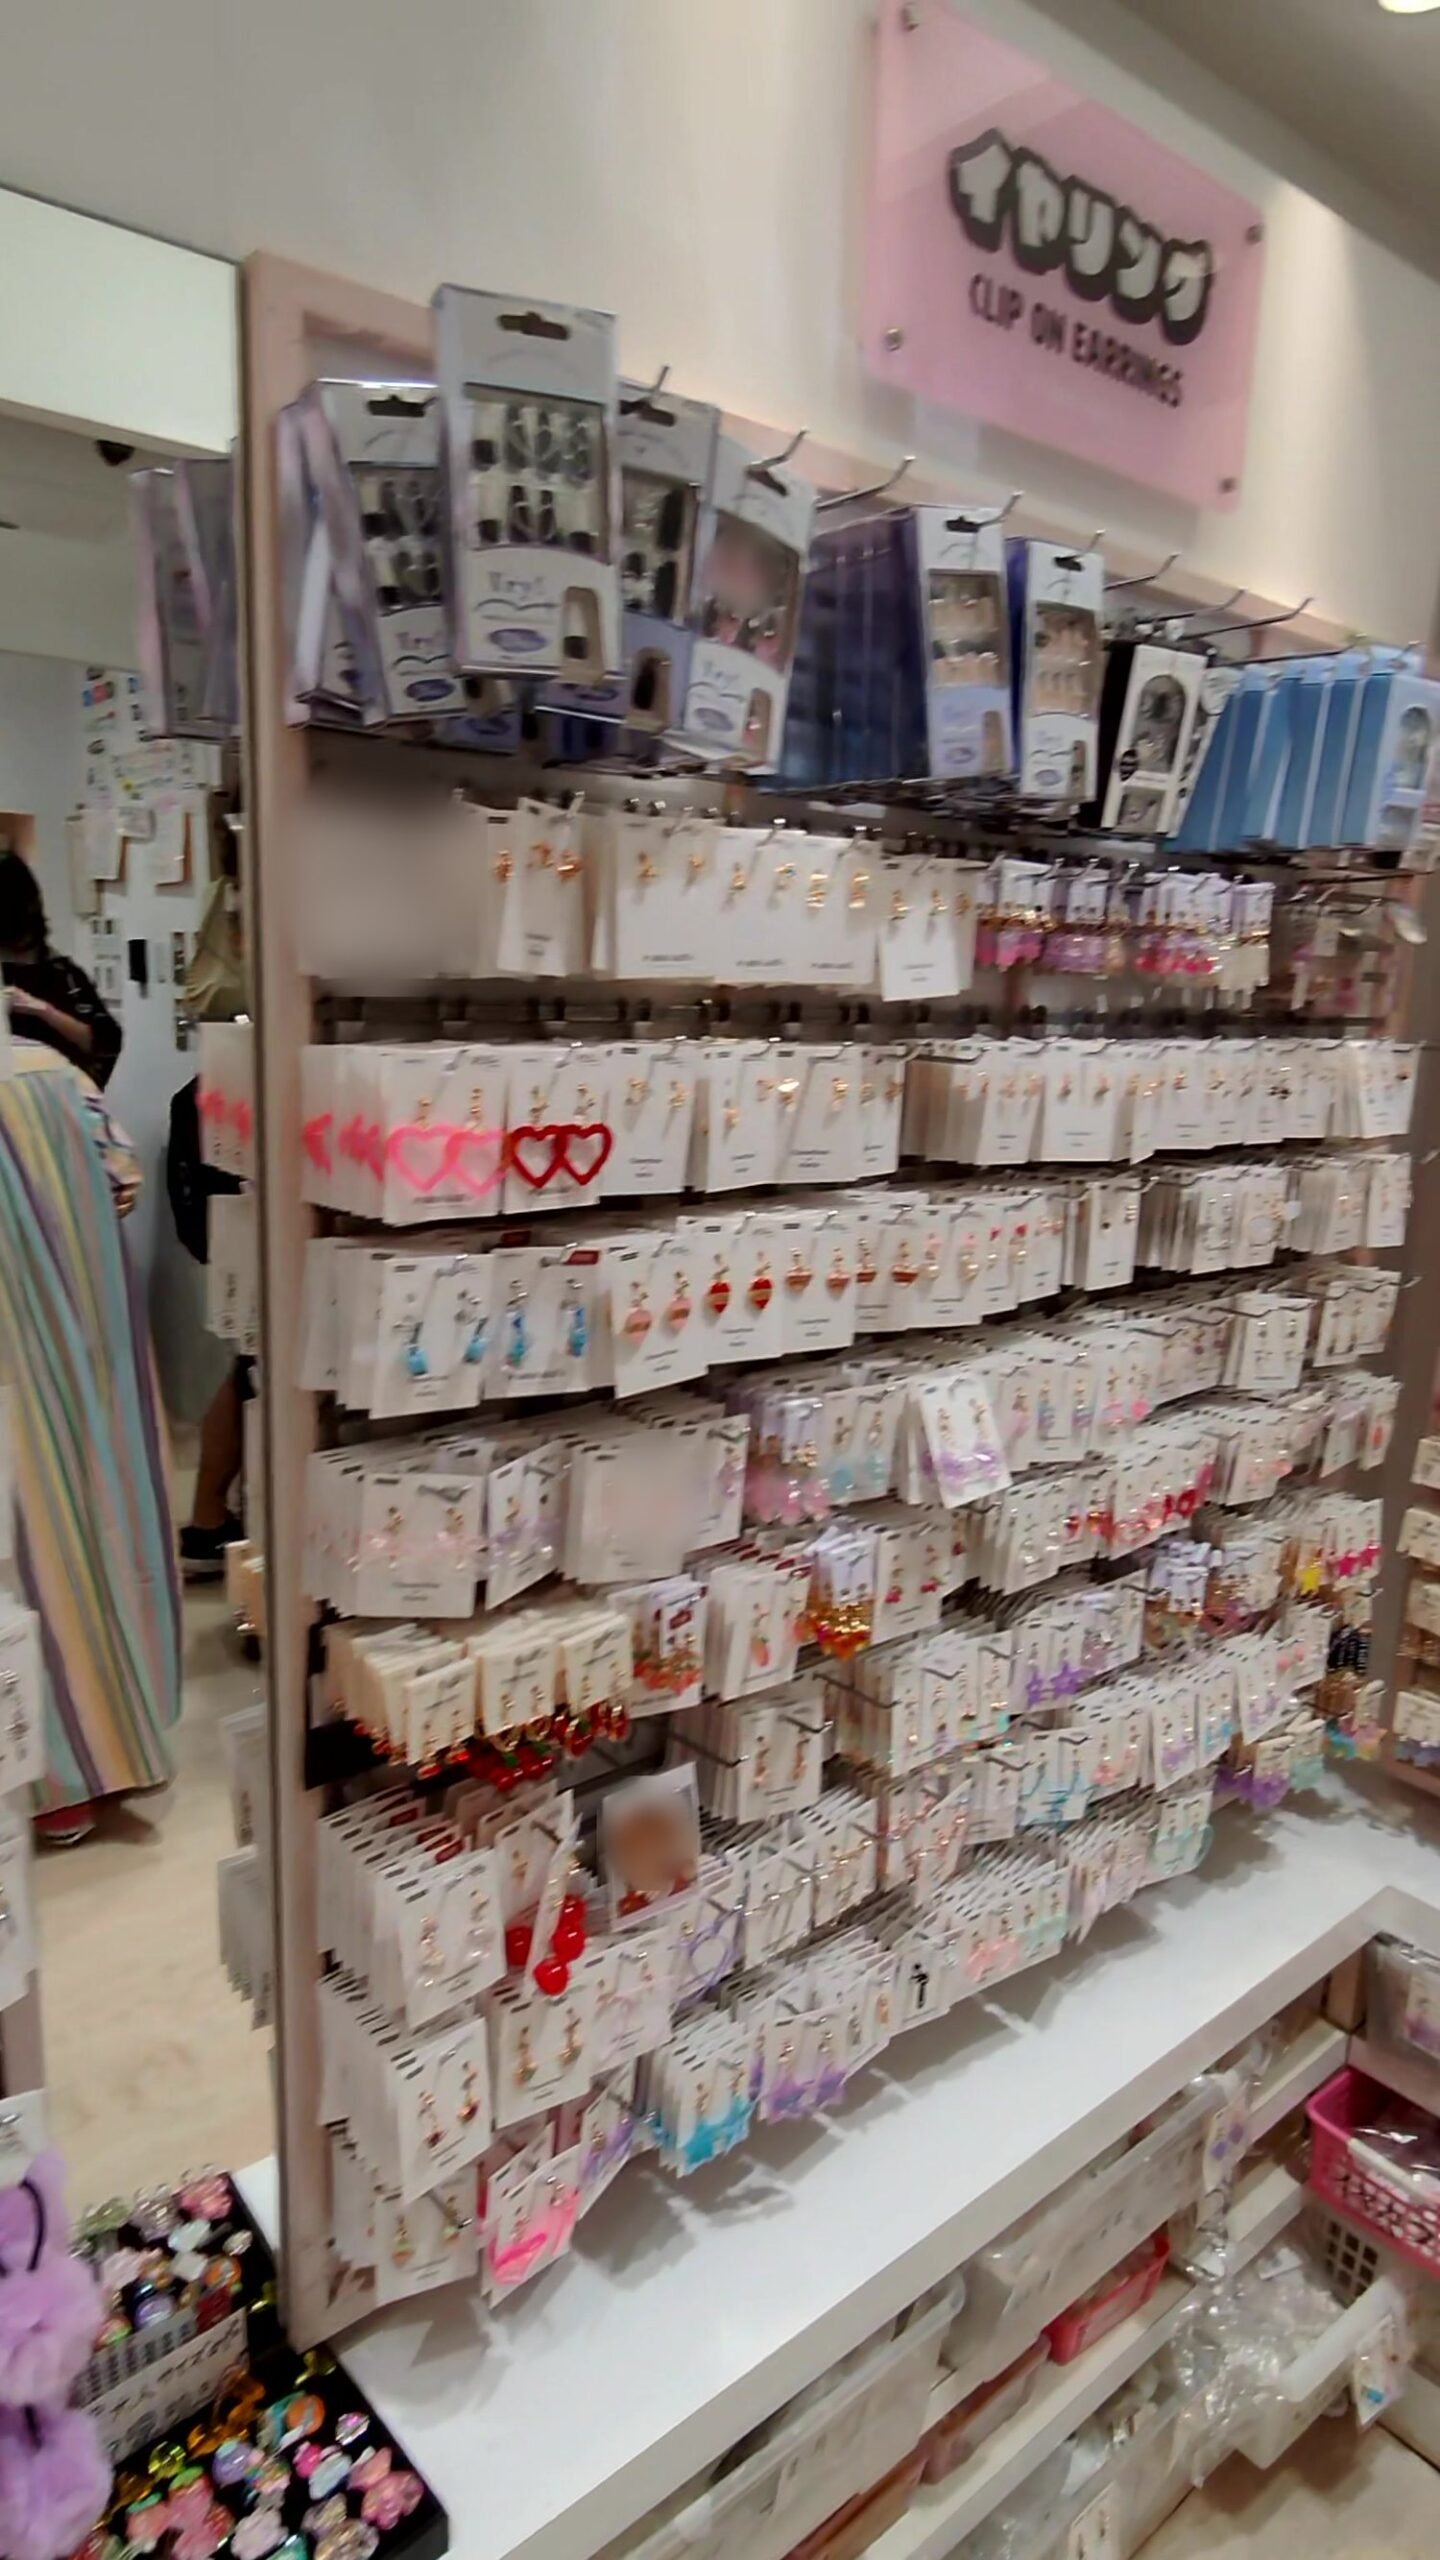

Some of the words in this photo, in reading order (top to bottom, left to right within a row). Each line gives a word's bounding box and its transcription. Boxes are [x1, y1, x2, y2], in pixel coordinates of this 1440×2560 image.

[948, 128, 1214, 345] イヤリング
[968, 273, 1024, 331] CLIP
[1031, 302, 1068, 355] ON
[1070, 321, 1184, 409] EARRINGS
